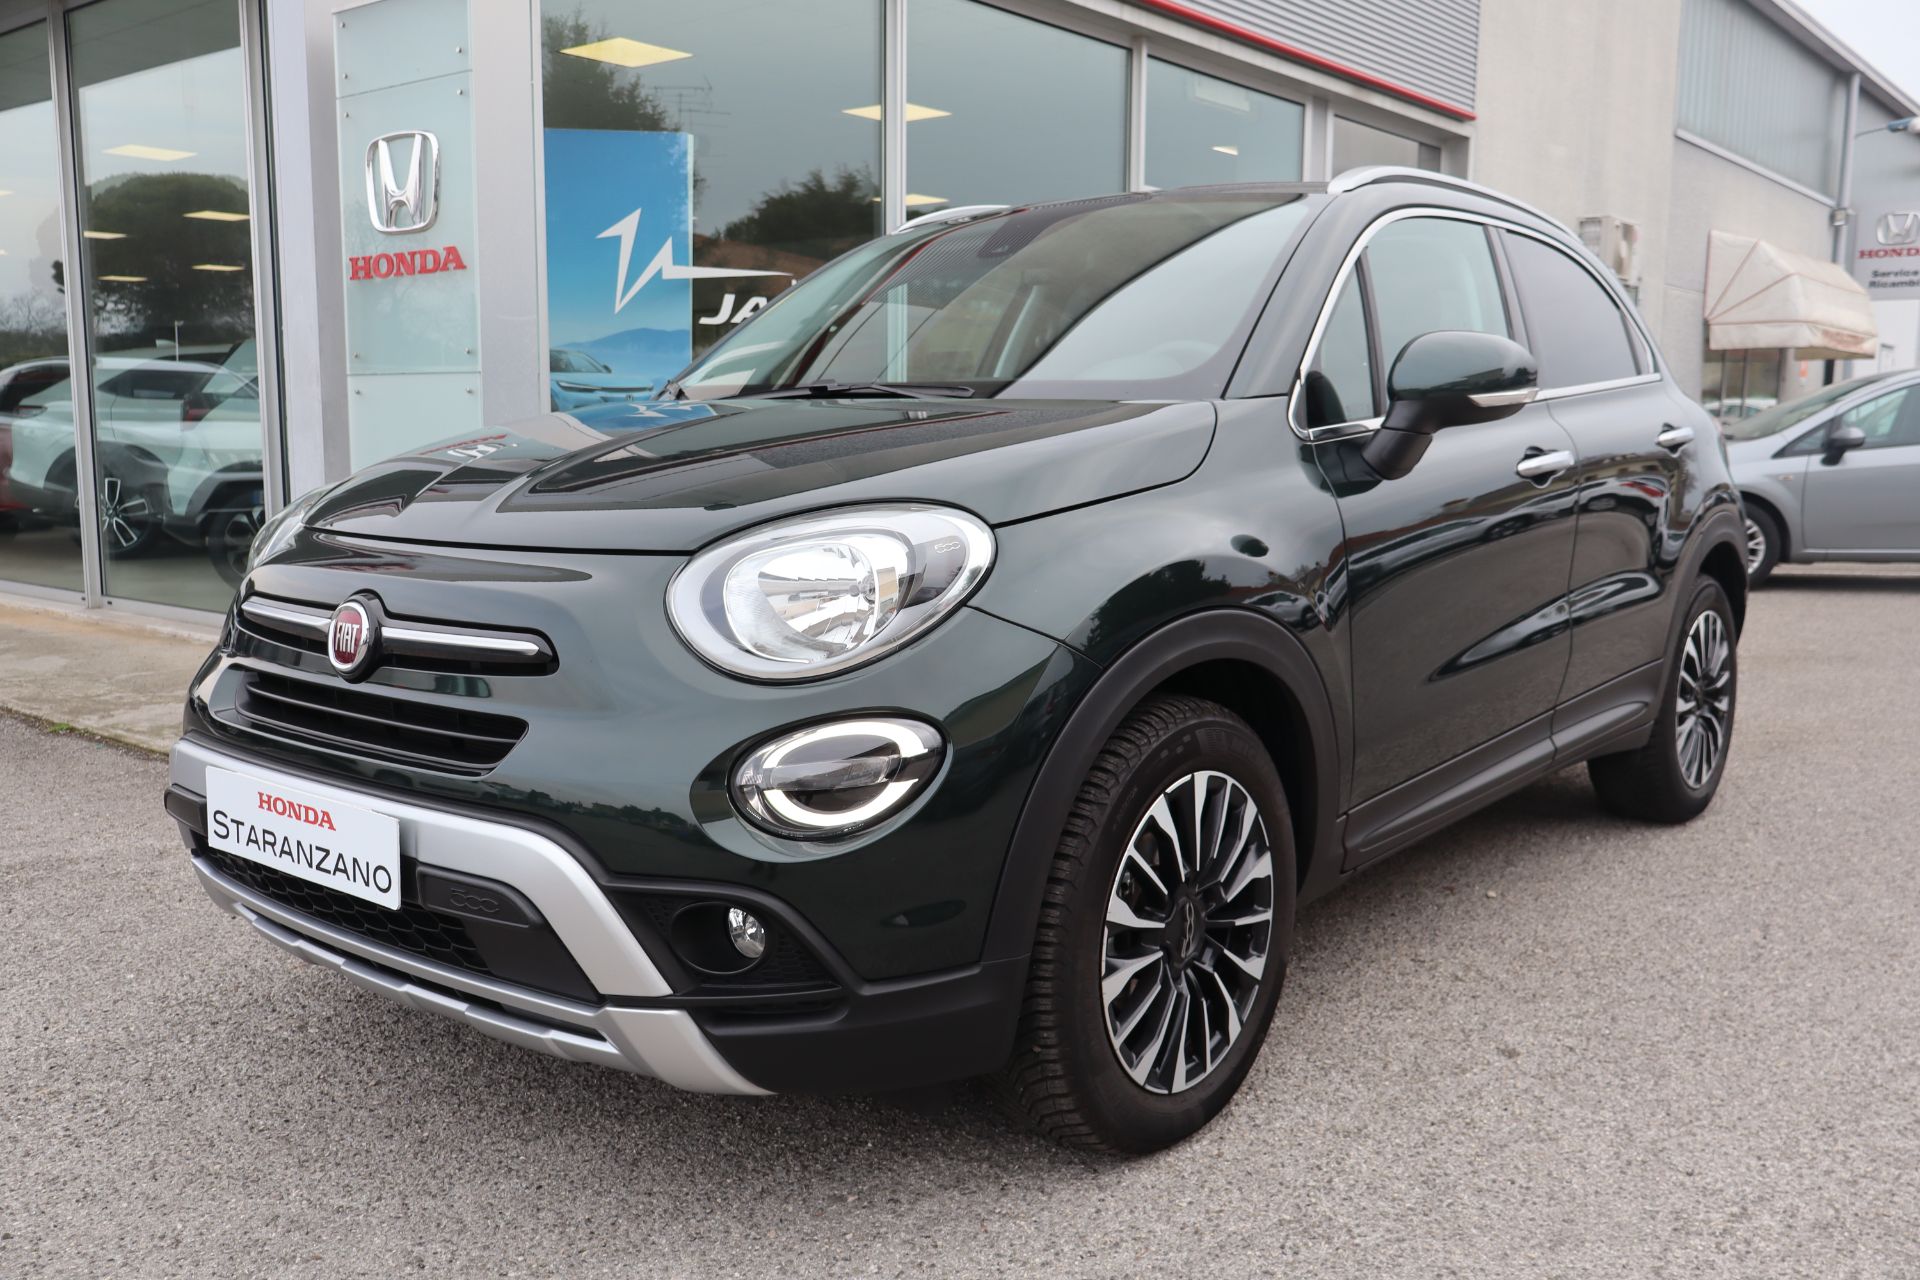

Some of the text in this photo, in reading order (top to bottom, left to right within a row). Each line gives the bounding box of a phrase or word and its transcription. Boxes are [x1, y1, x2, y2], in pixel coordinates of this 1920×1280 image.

[349, 246, 467, 280] HONDA
[335, 621, 361, 655] FIAT
[257, 791, 337, 831] HONDA
[213, 809, 392, 894] STARANZANO
